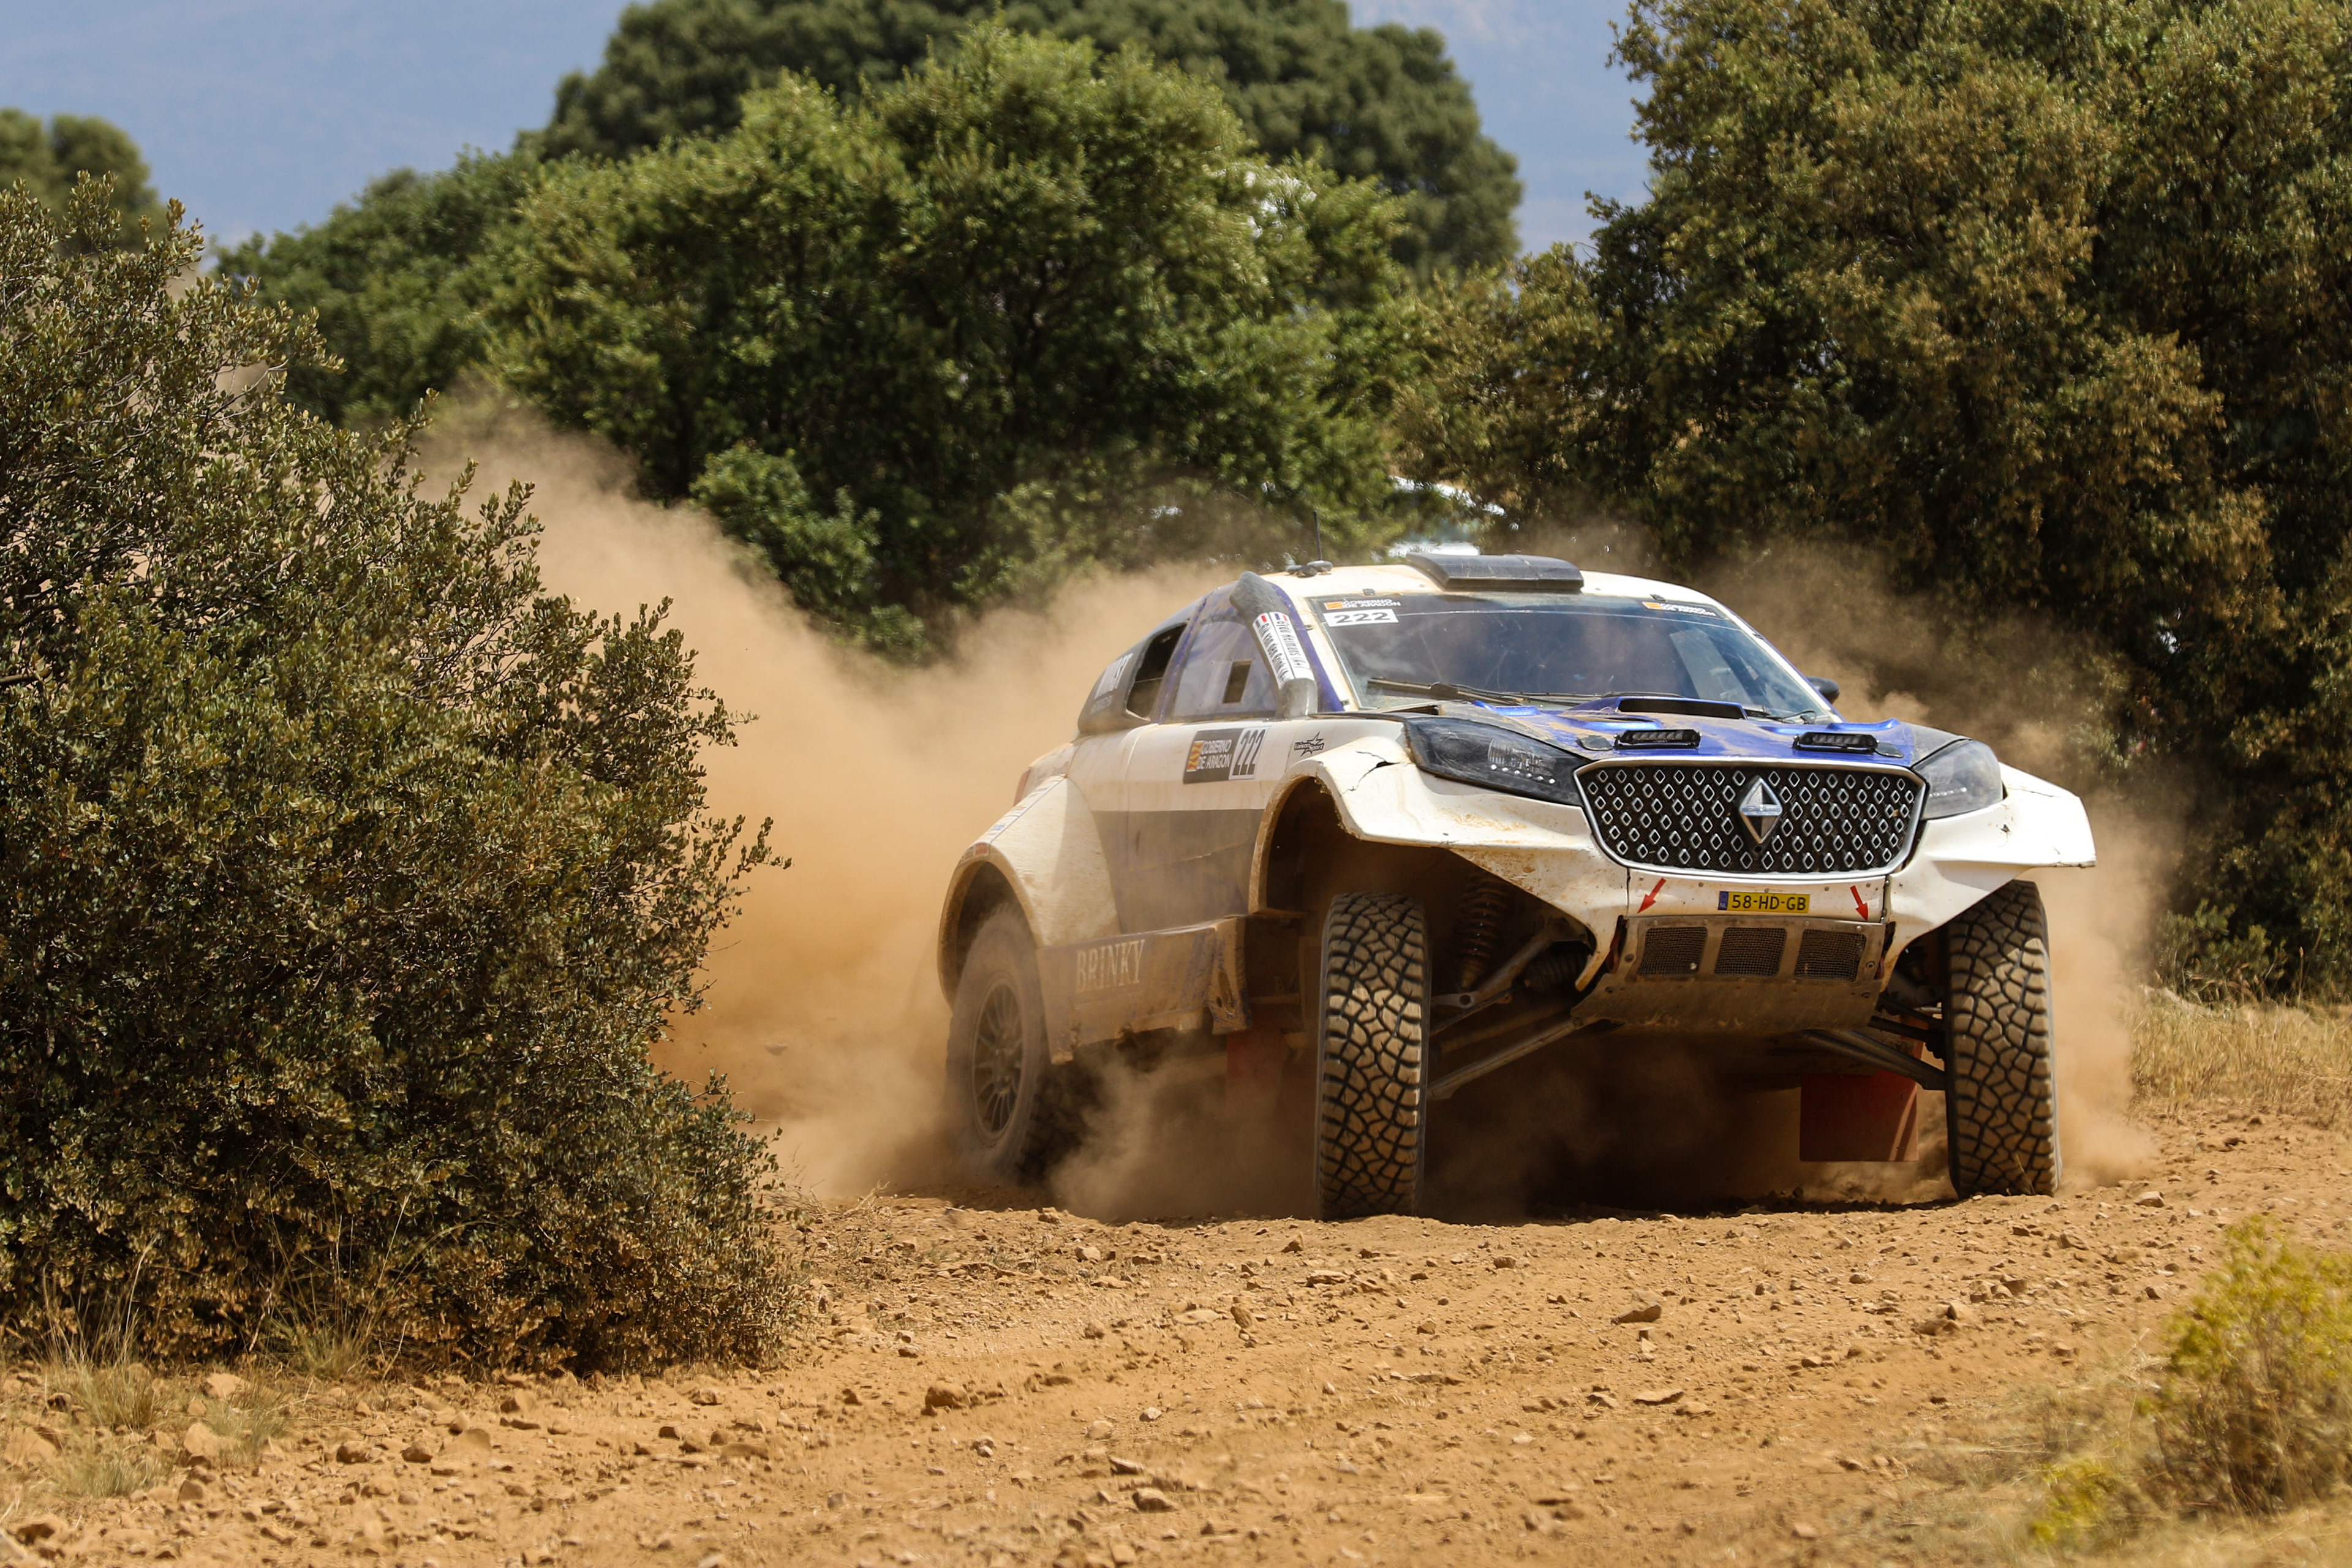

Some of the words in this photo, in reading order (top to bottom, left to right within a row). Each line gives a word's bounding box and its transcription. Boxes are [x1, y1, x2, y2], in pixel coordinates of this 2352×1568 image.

[1333, 612, 1392, 624] 222
[1201, 739, 1232, 755] GOBIERNO
[1232, 729, 1266, 776] 222
[1197, 756, 1207, 770] DE
[1206, 754, 1232, 769] ARAGON
[1732, 894, 1806, 911] 58-HD-GB
[1076, 939, 1145, 993] BRINKY
